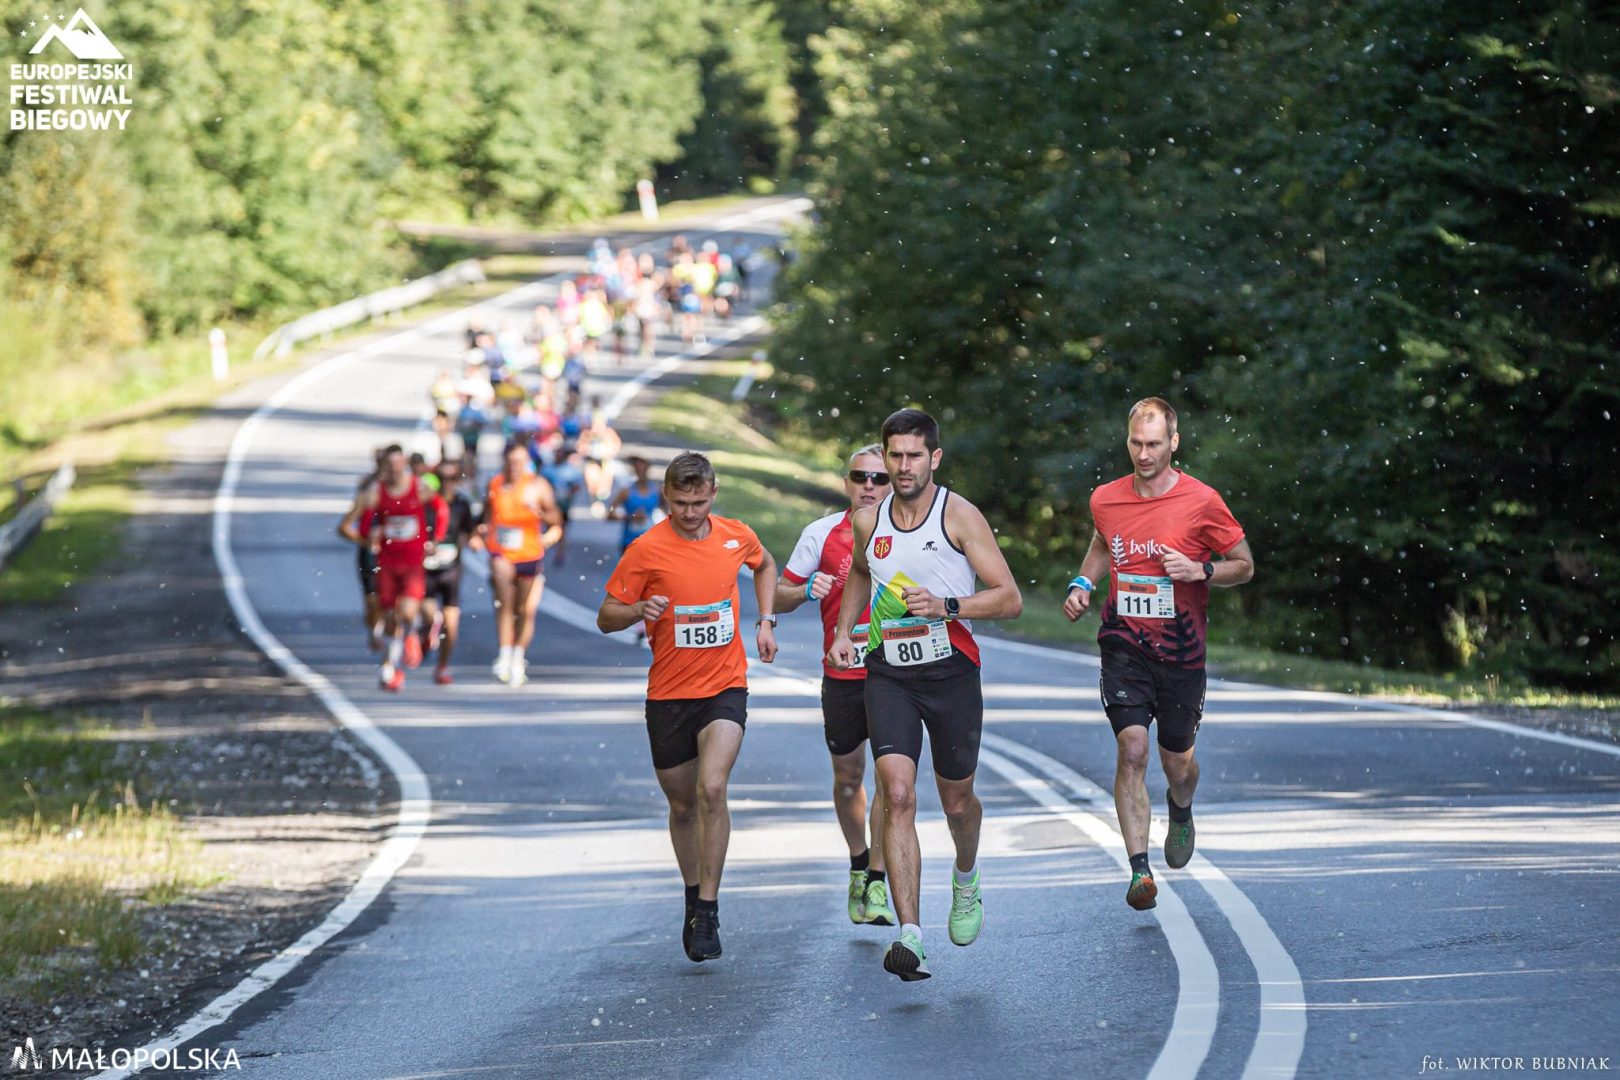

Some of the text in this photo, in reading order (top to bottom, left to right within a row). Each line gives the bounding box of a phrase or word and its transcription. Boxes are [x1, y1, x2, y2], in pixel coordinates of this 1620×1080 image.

[1124, 595, 1151, 615] 111
[681, 625, 717, 645] 158
[897, 641, 923, 663] 80
